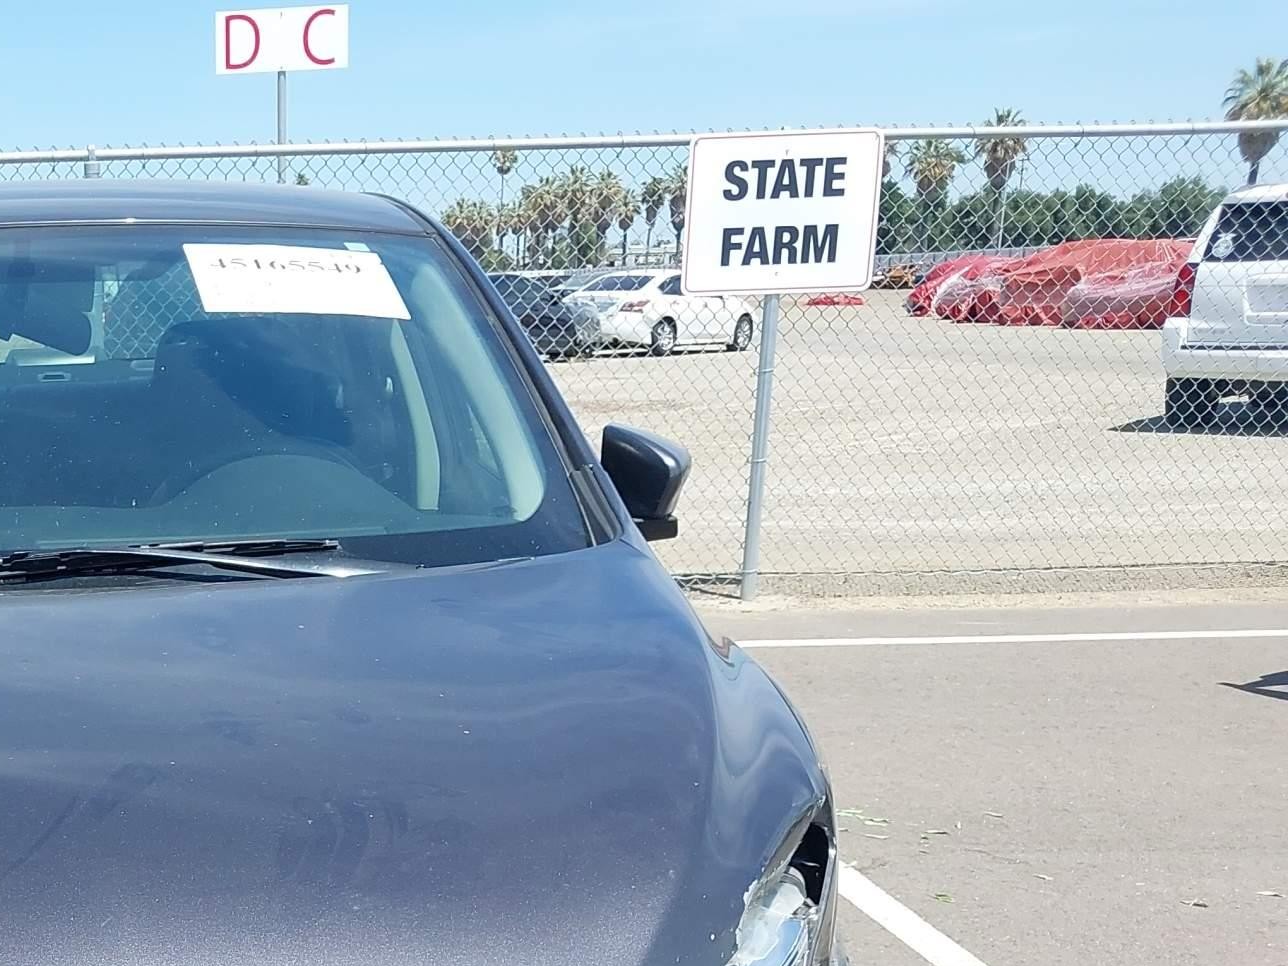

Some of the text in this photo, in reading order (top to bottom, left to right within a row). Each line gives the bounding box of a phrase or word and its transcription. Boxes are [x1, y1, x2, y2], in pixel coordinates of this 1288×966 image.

[225, 8, 336, 70] D C
[722, 156, 848, 202] STATE
[720, 223, 840, 267] FARM
